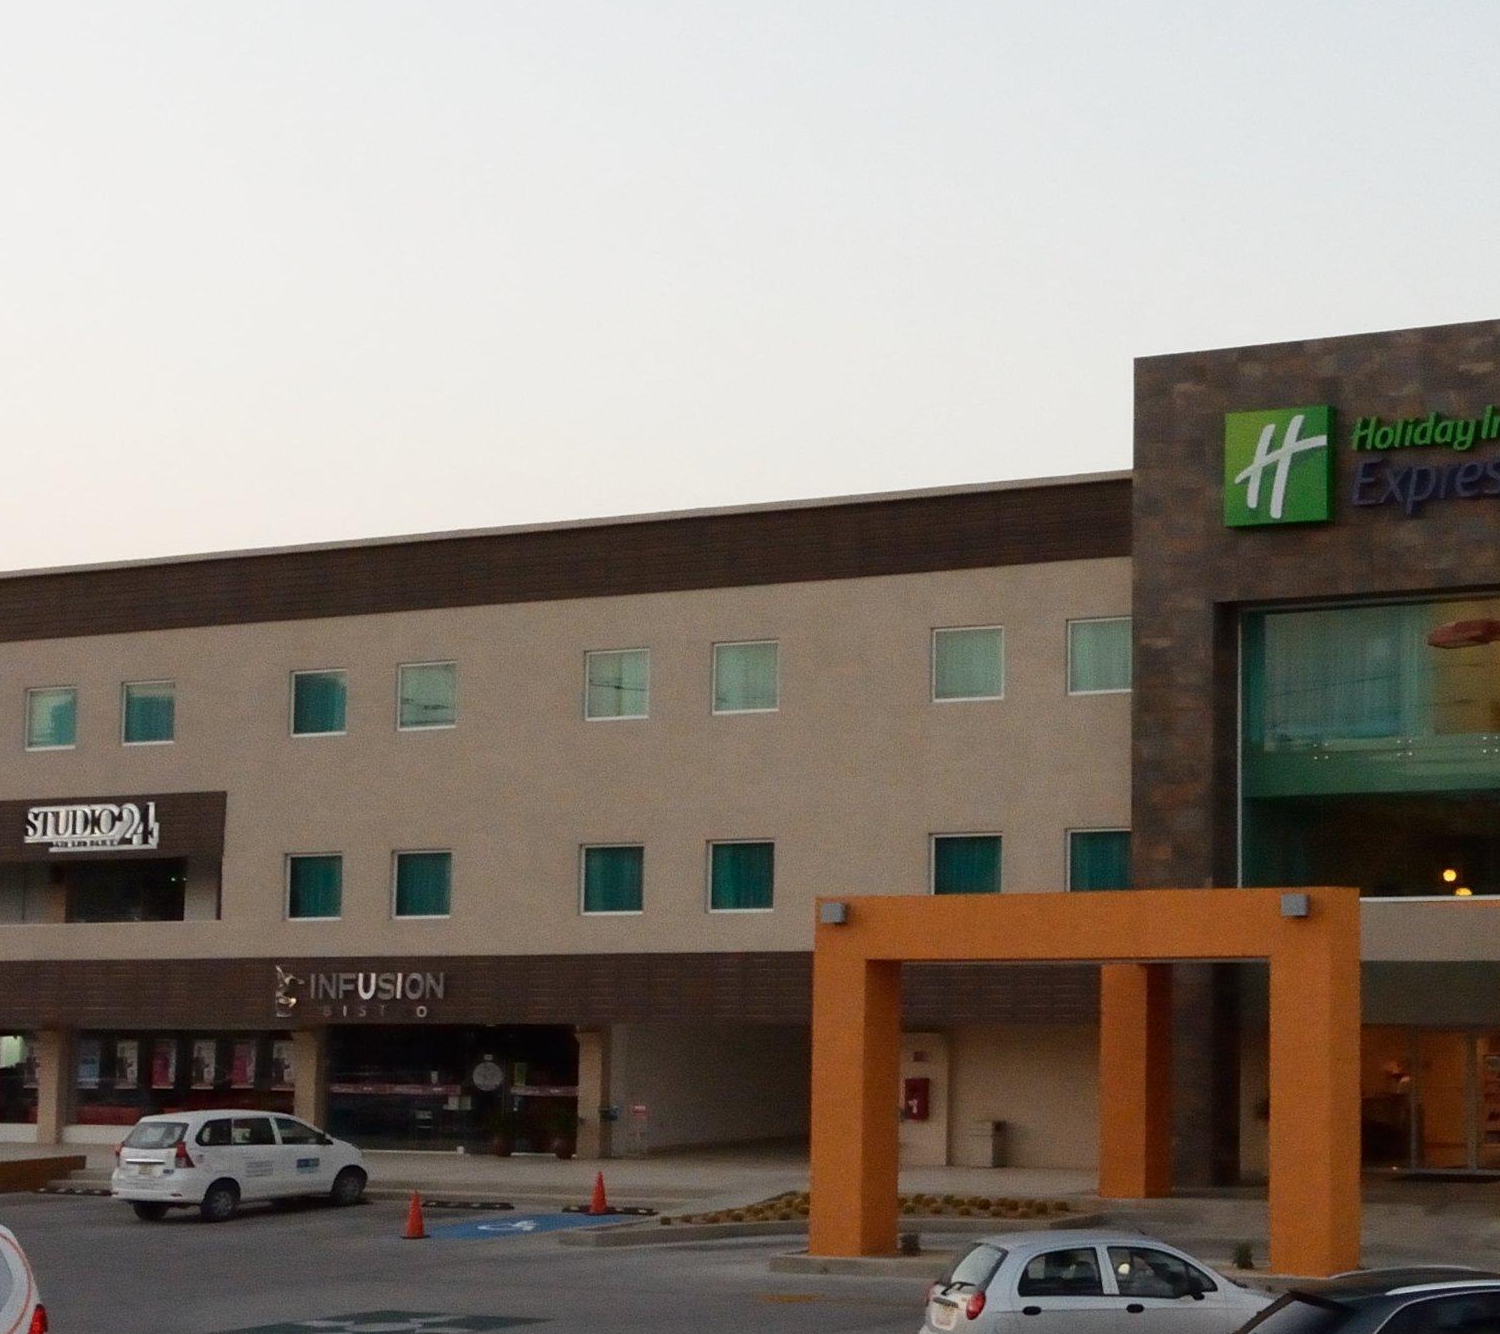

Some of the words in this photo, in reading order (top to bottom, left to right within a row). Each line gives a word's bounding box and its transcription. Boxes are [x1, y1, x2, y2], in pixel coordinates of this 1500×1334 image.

[1351, 411, 1476, 451] Holiday
[24, 807, 121, 837] STUDIO
[117, 801, 160, 848] 24
[310, 972, 444, 1000] INFUSION
[323, 1005, 428, 1018] BISTO
